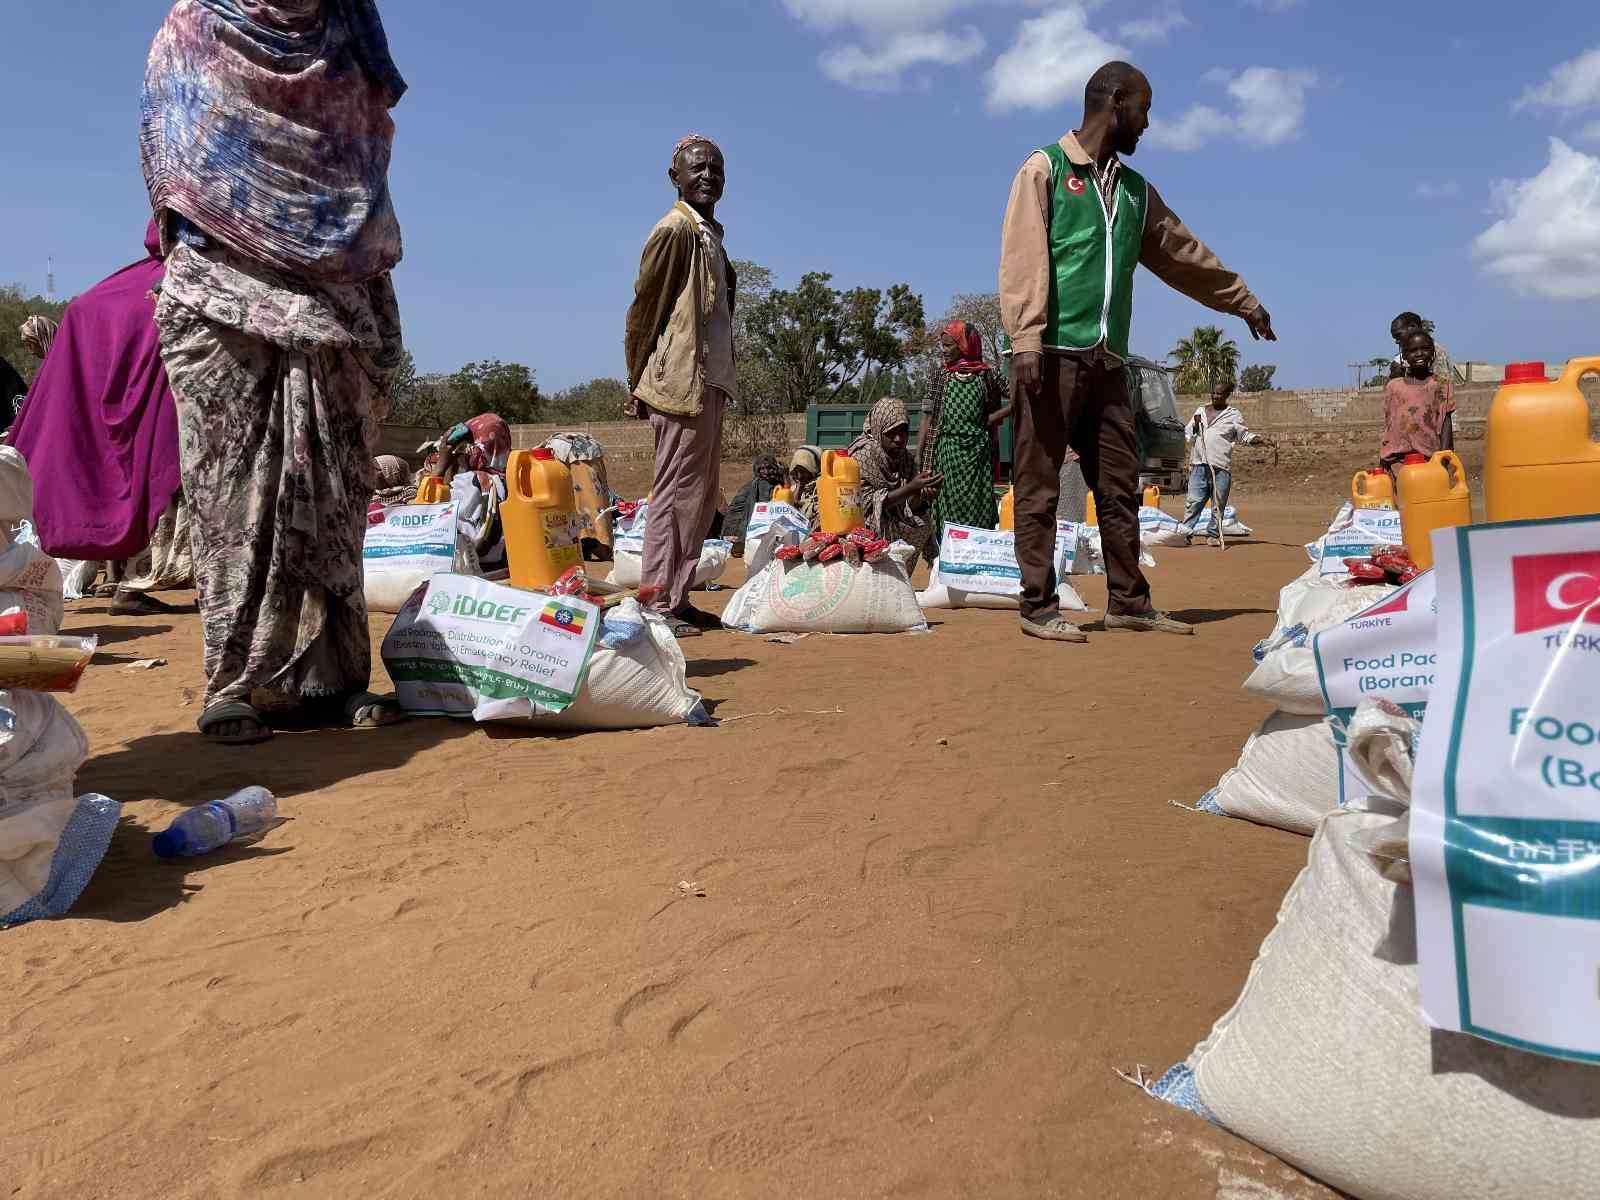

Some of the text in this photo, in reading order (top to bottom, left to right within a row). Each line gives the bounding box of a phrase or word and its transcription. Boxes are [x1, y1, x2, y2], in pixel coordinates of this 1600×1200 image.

[520, 644, 569, 667] Oromia
[1343, 653, 1395, 672] Food
[520, 658, 558, 677] Relief
[1508, 706, 1600, 746] Foo
